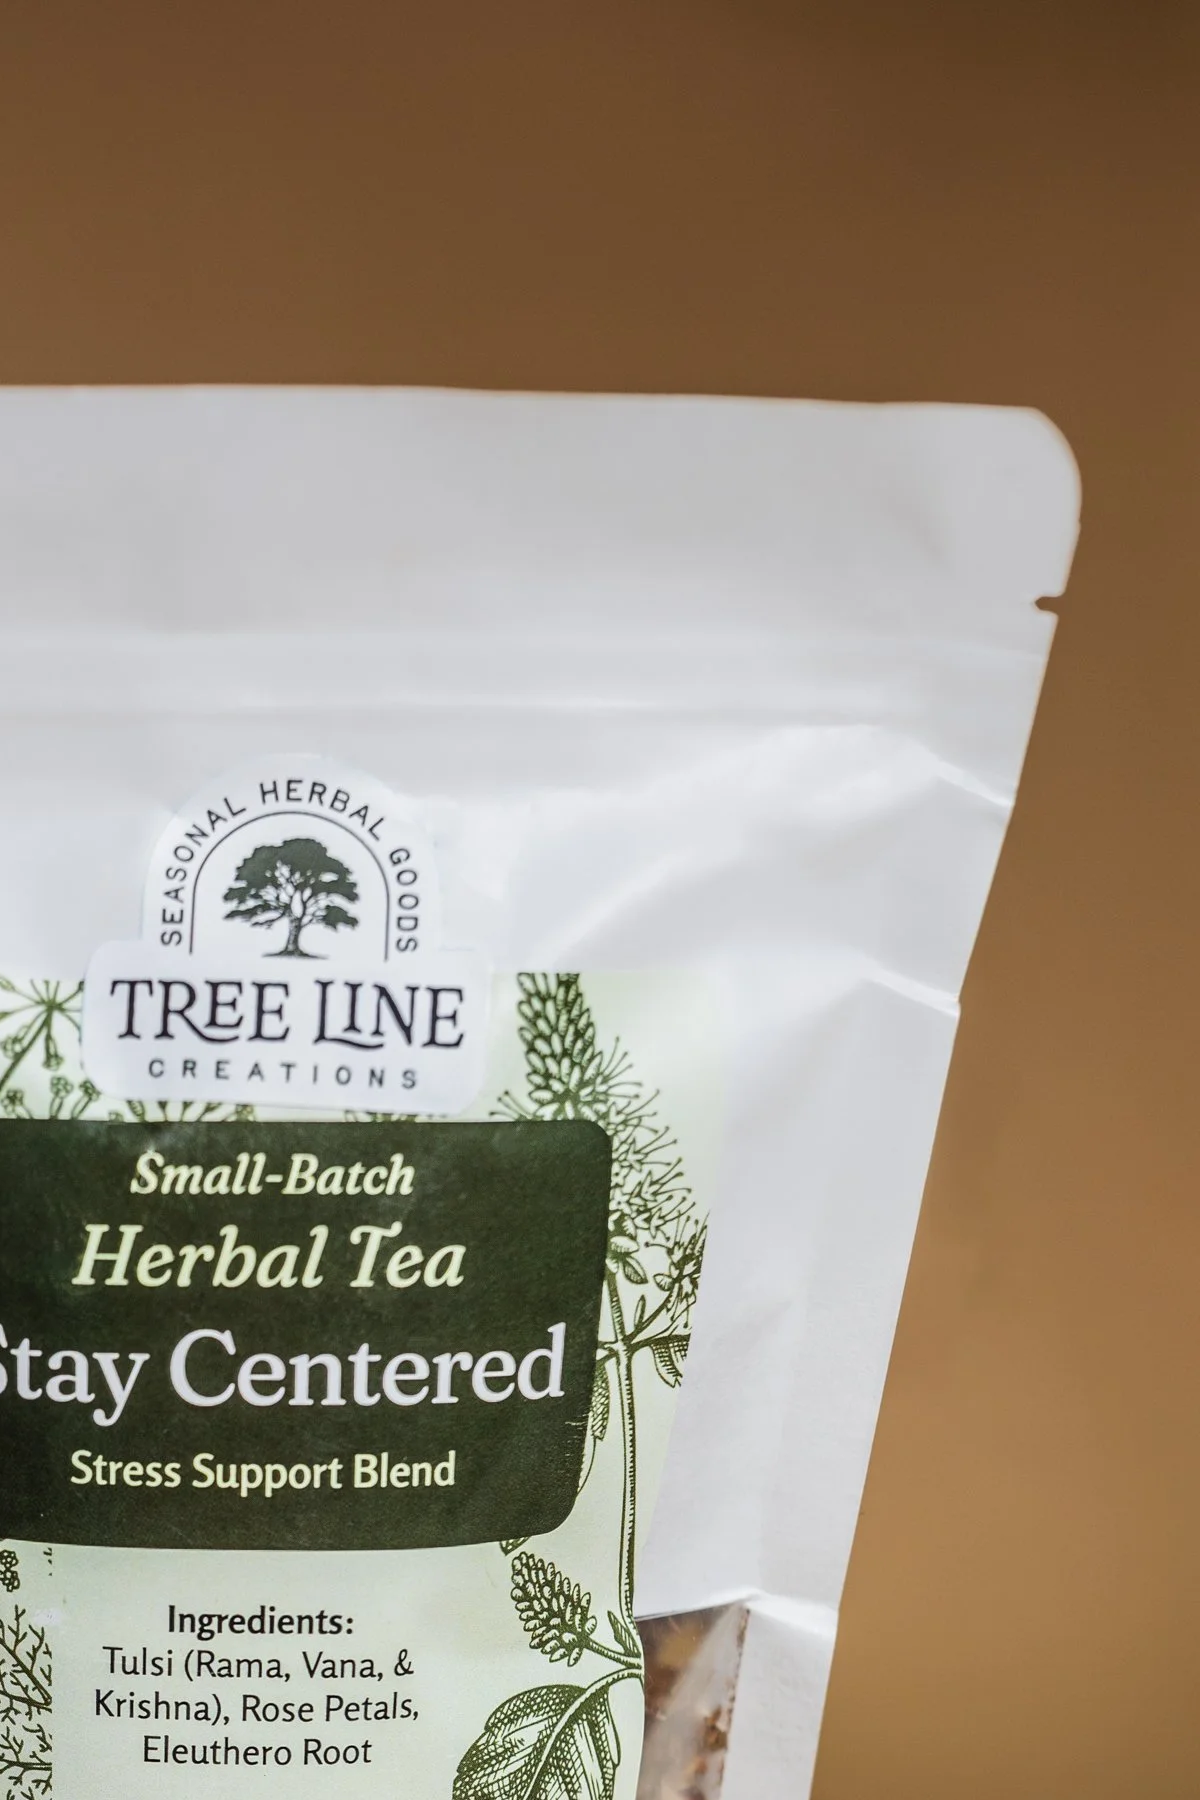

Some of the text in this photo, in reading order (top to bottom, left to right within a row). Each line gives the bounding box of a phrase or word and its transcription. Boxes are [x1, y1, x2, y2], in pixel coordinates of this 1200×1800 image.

[161, 779, 420, 953] SEASONAL HERBAL GOODS
[110, 979, 465, 1050] TREE LINE
[148, 1058, 417, 1088] CREATIONS
[130, 1151, 414, 1196] Small-Batch
[72, 1221, 466, 1289] Herbal Tea
[169, 1322, 567, 1407] Centered
[70, 1449, 456, 1497] Stress Support Blend
[167, 1604, 354, 1640] Ingredients:
[102, 1646, 415, 1682] Tulsi (Rama, Vana, &
[95, 1688, 420, 1726] Krishna), Rose Petals,
[143, 1735, 373, 1766] Eleuthero Root
